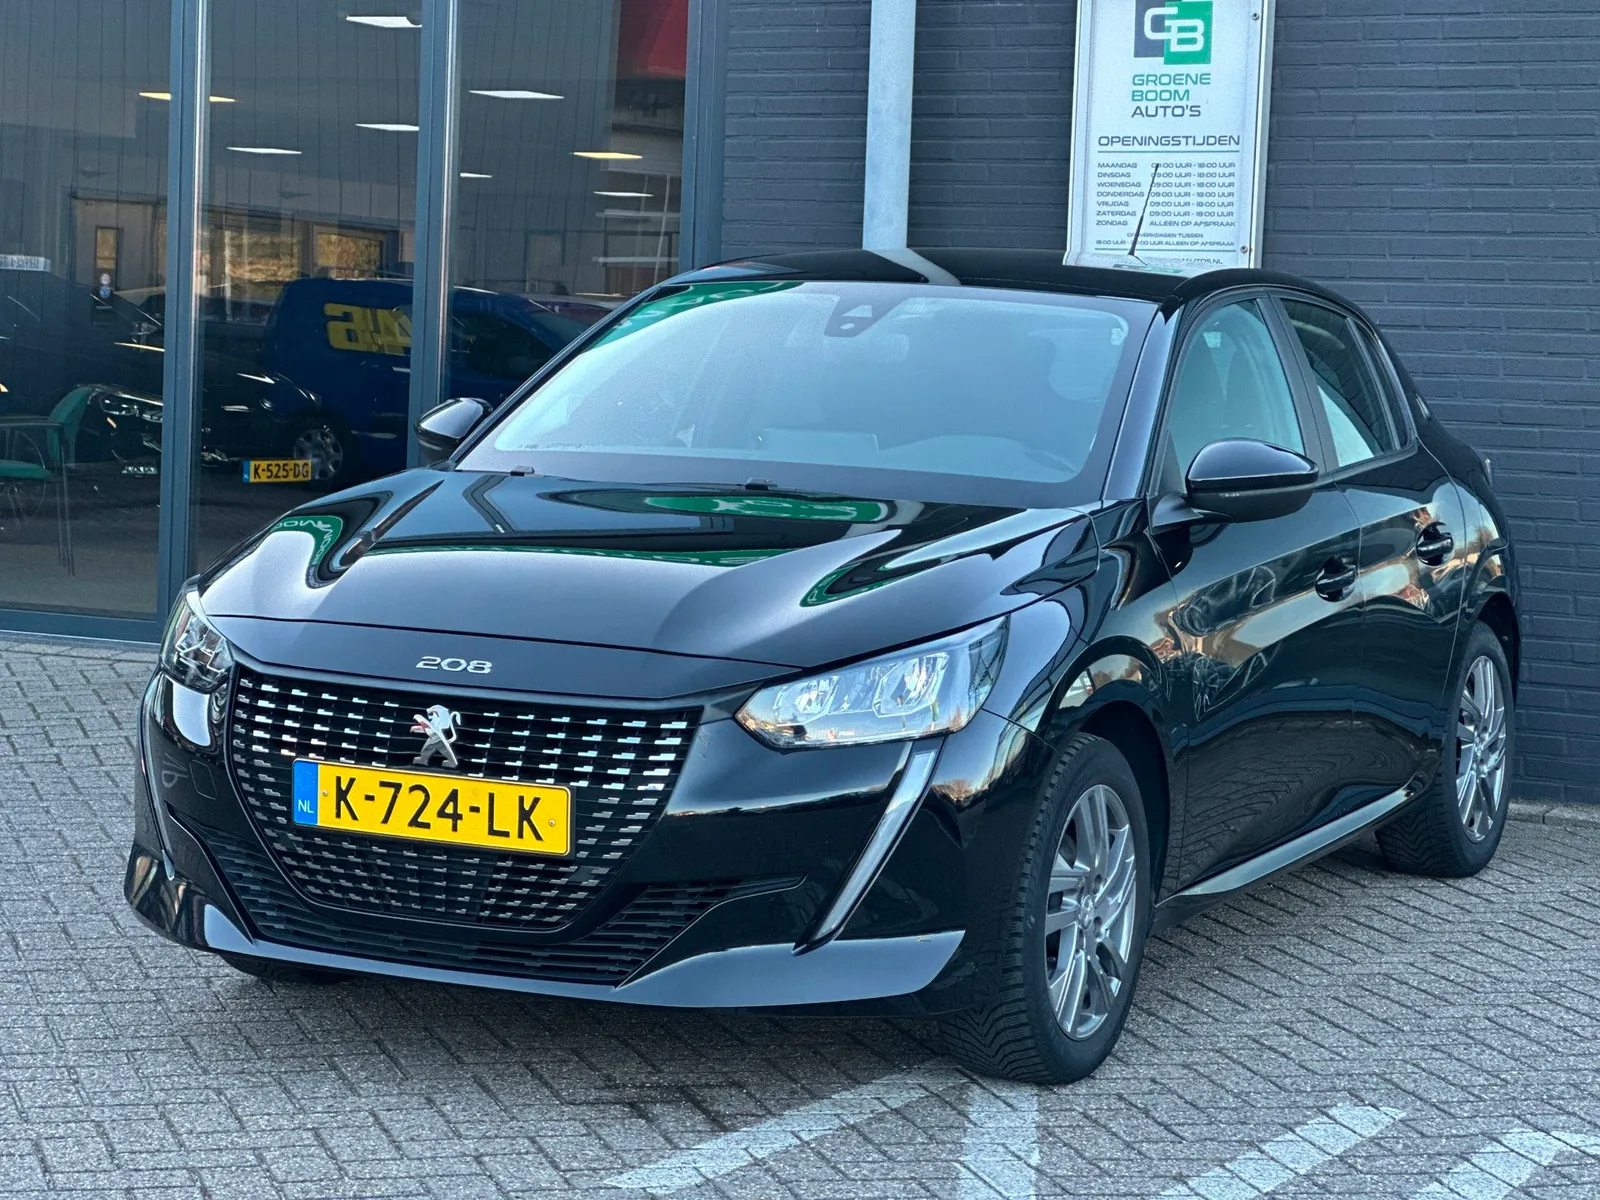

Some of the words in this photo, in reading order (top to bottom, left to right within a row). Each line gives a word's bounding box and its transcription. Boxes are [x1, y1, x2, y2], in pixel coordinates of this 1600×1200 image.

[1131, 72, 1212, 87] GROENE
[1131, 89, 1190, 102] BOOM
[1131, 104, 1201, 118] AUTO'S
[1097, 135, 1240, 147] OPENINGSTIJDEN
[253, 463, 309, 480] K-525-DG
[415, 655, 493, 674] 208
[297, 799, 315, 814] NL
[335, 775, 544, 842] K-724-LK
